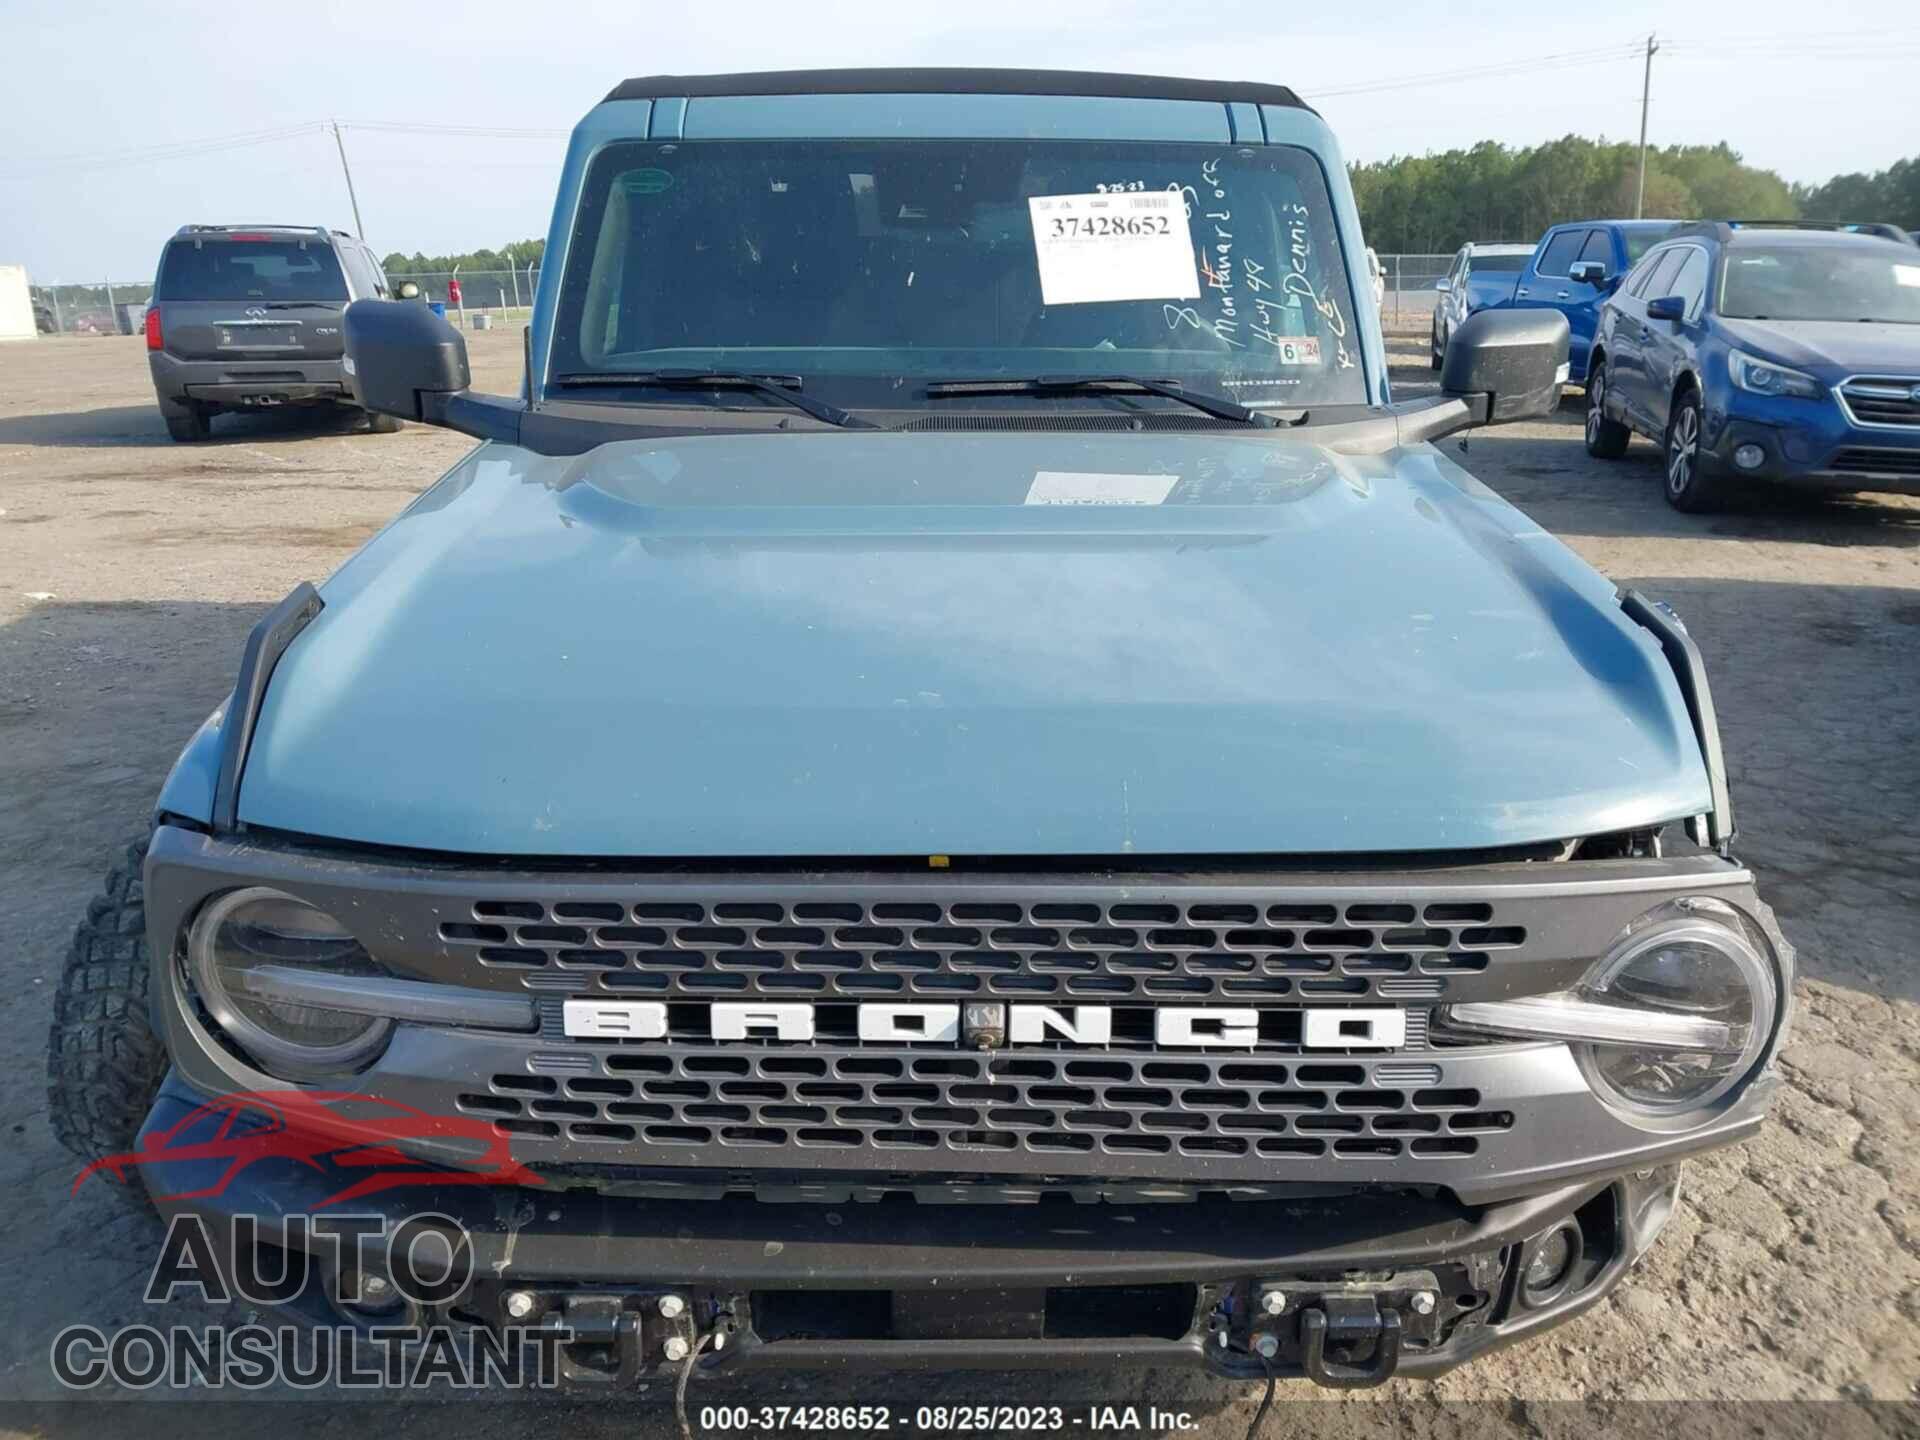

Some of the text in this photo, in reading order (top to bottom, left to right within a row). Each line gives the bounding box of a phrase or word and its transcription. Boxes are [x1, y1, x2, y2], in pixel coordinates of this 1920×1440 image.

[1051, 215, 1171, 238] 37428652
[1282, 202, 1315, 298] Dennis
[1283, 343, 1295, 360] 6
[563, 1000, 1406, 1049] BRONCO
